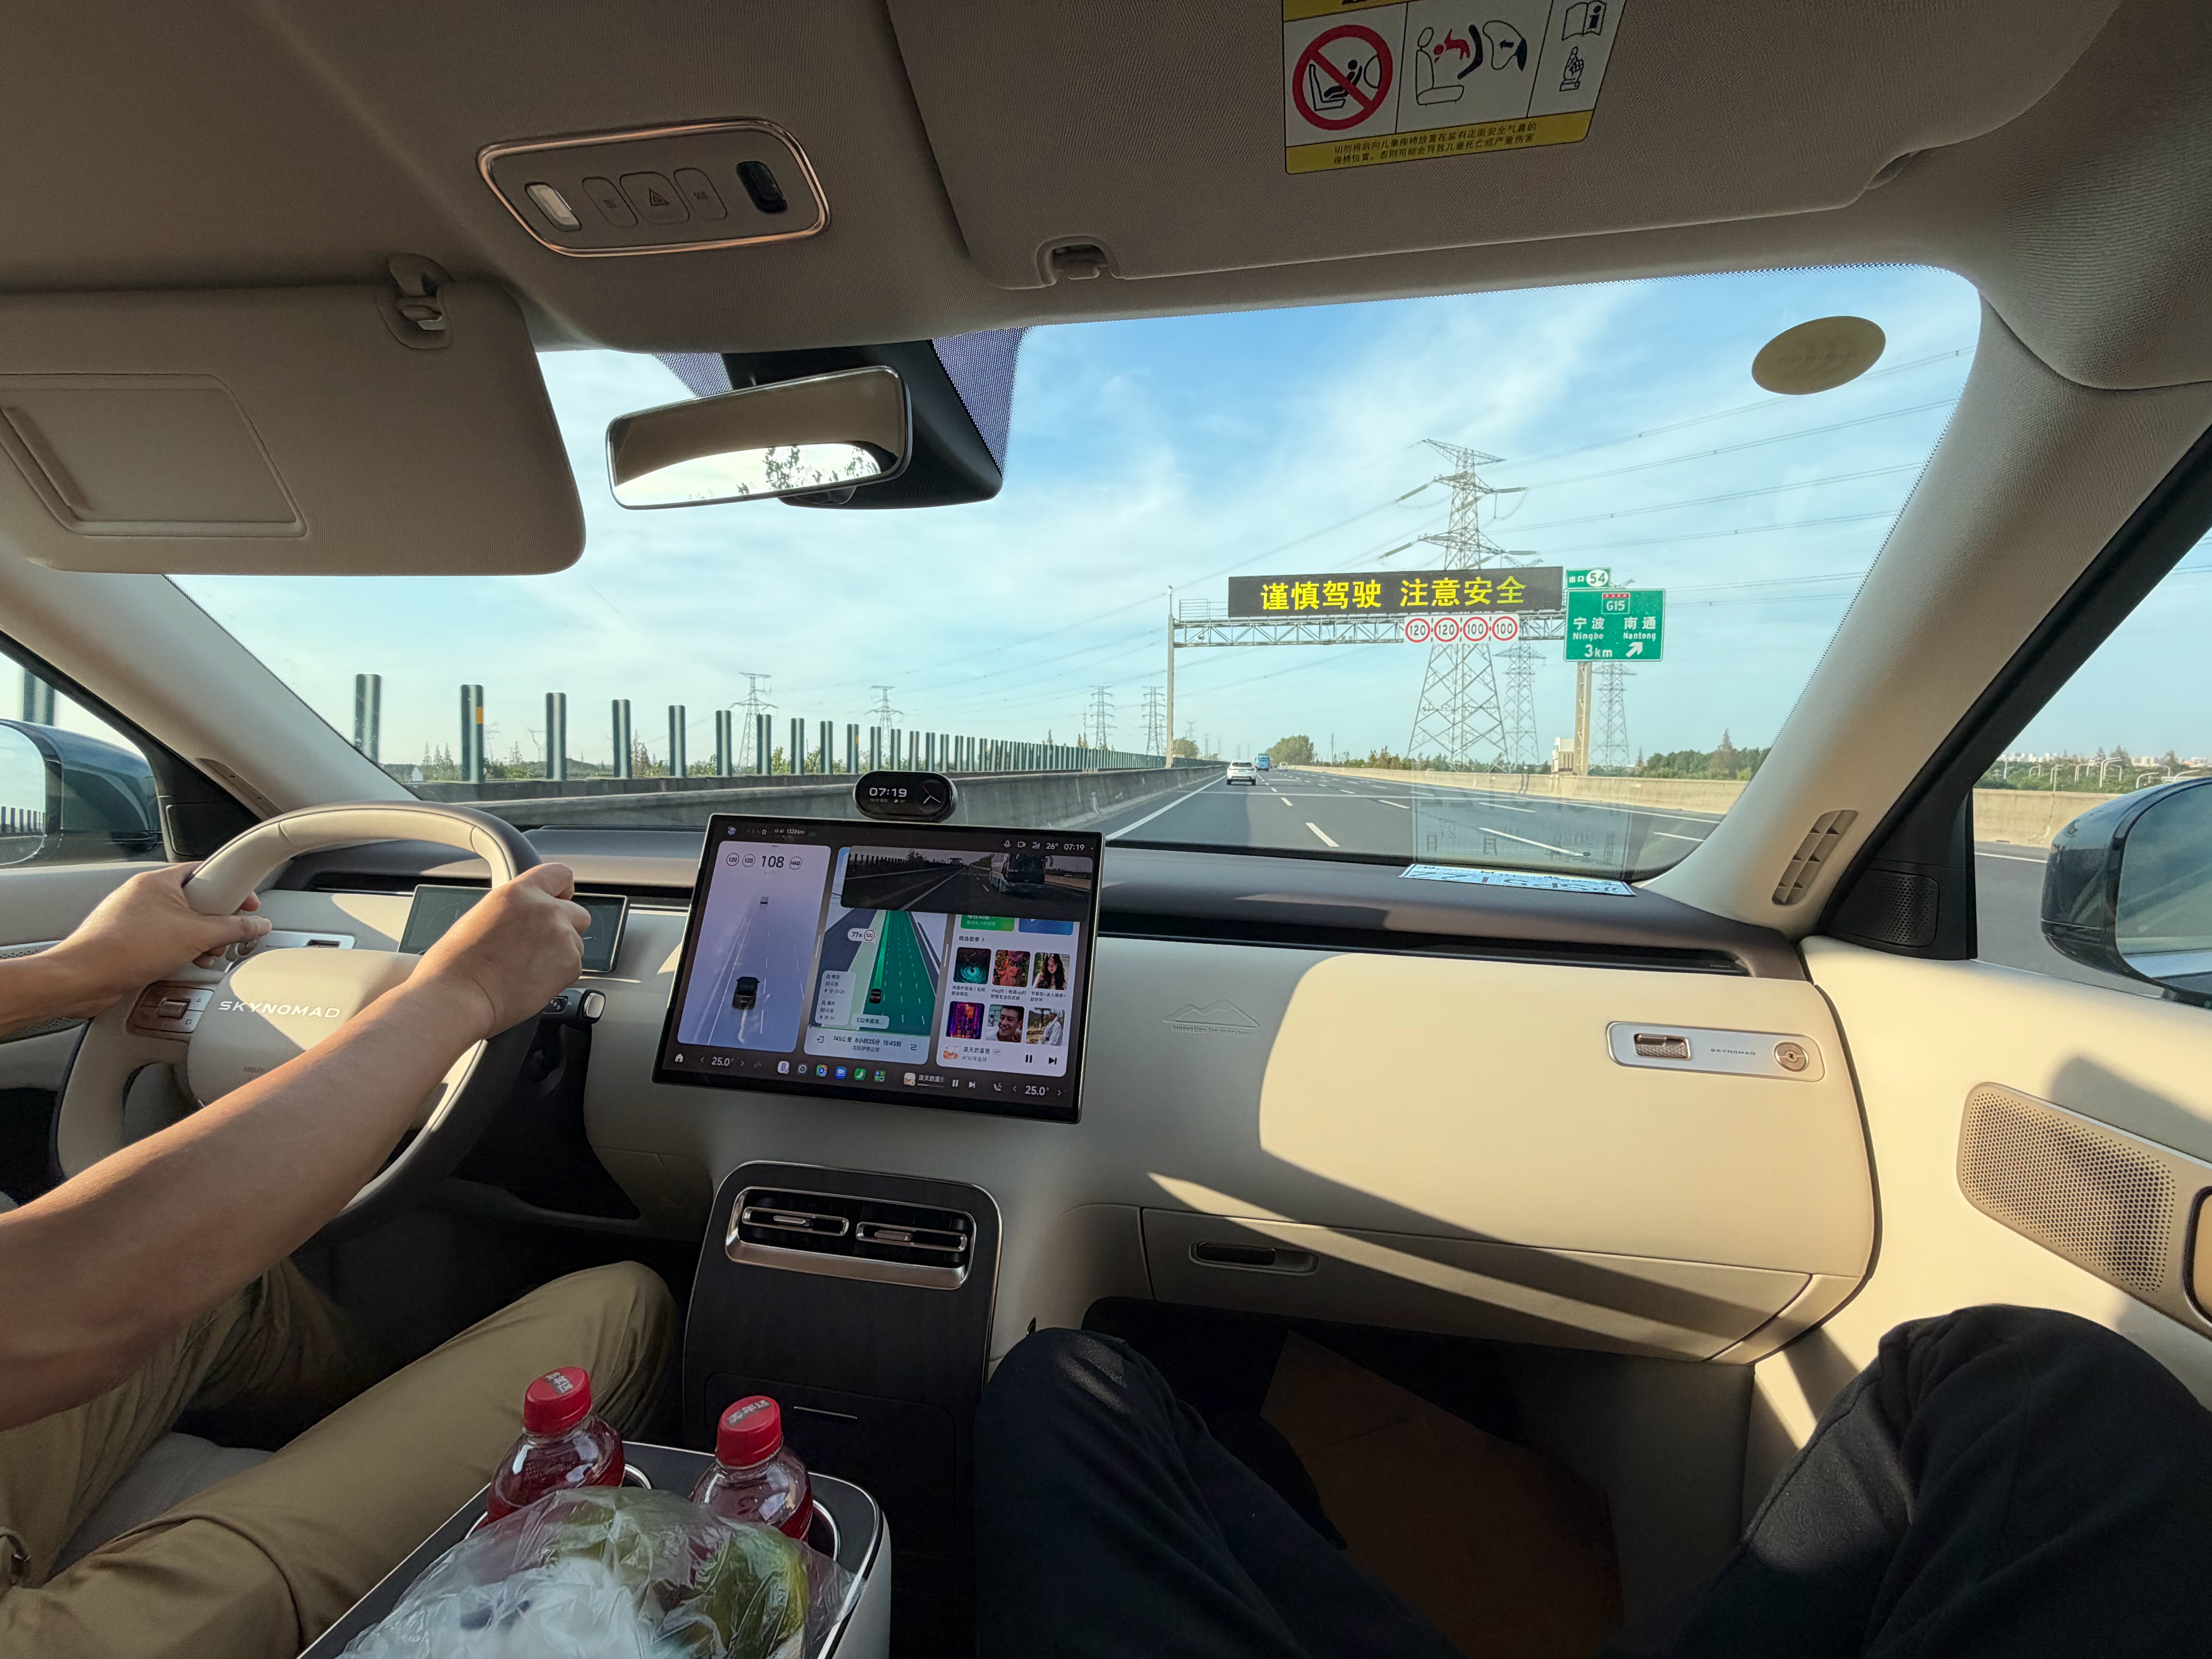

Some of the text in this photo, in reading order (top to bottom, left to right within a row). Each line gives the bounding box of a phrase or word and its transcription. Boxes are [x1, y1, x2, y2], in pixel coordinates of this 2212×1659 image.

[1589, 572, 1606, 584] 54
[1260, 575, 1527, 610] 谨慎驾驶 注意安全
[1606, 600, 1625, 611] G15
[1496, 623, 1513, 634] 100
[1573, 617, 1605, 630] 宁波
[1624, 616, 1656, 630] 南通
[1410, 625, 1426, 636] 120
[1438, 624, 1455, 635] 120
[1467, 623, 1484, 635] 100
[1573, 632, 1604, 642] Ningbo
[1623, 632, 1656, 642] Nantong
[1584, 644, 1613, 658] 3km
[869, 787, 907, 797] 07:19
[761, 855, 785, 868] 108
[218, 1000, 340, 1018] SKYNOMAD
[1172, 1025, 1206, 1033] Innovation
